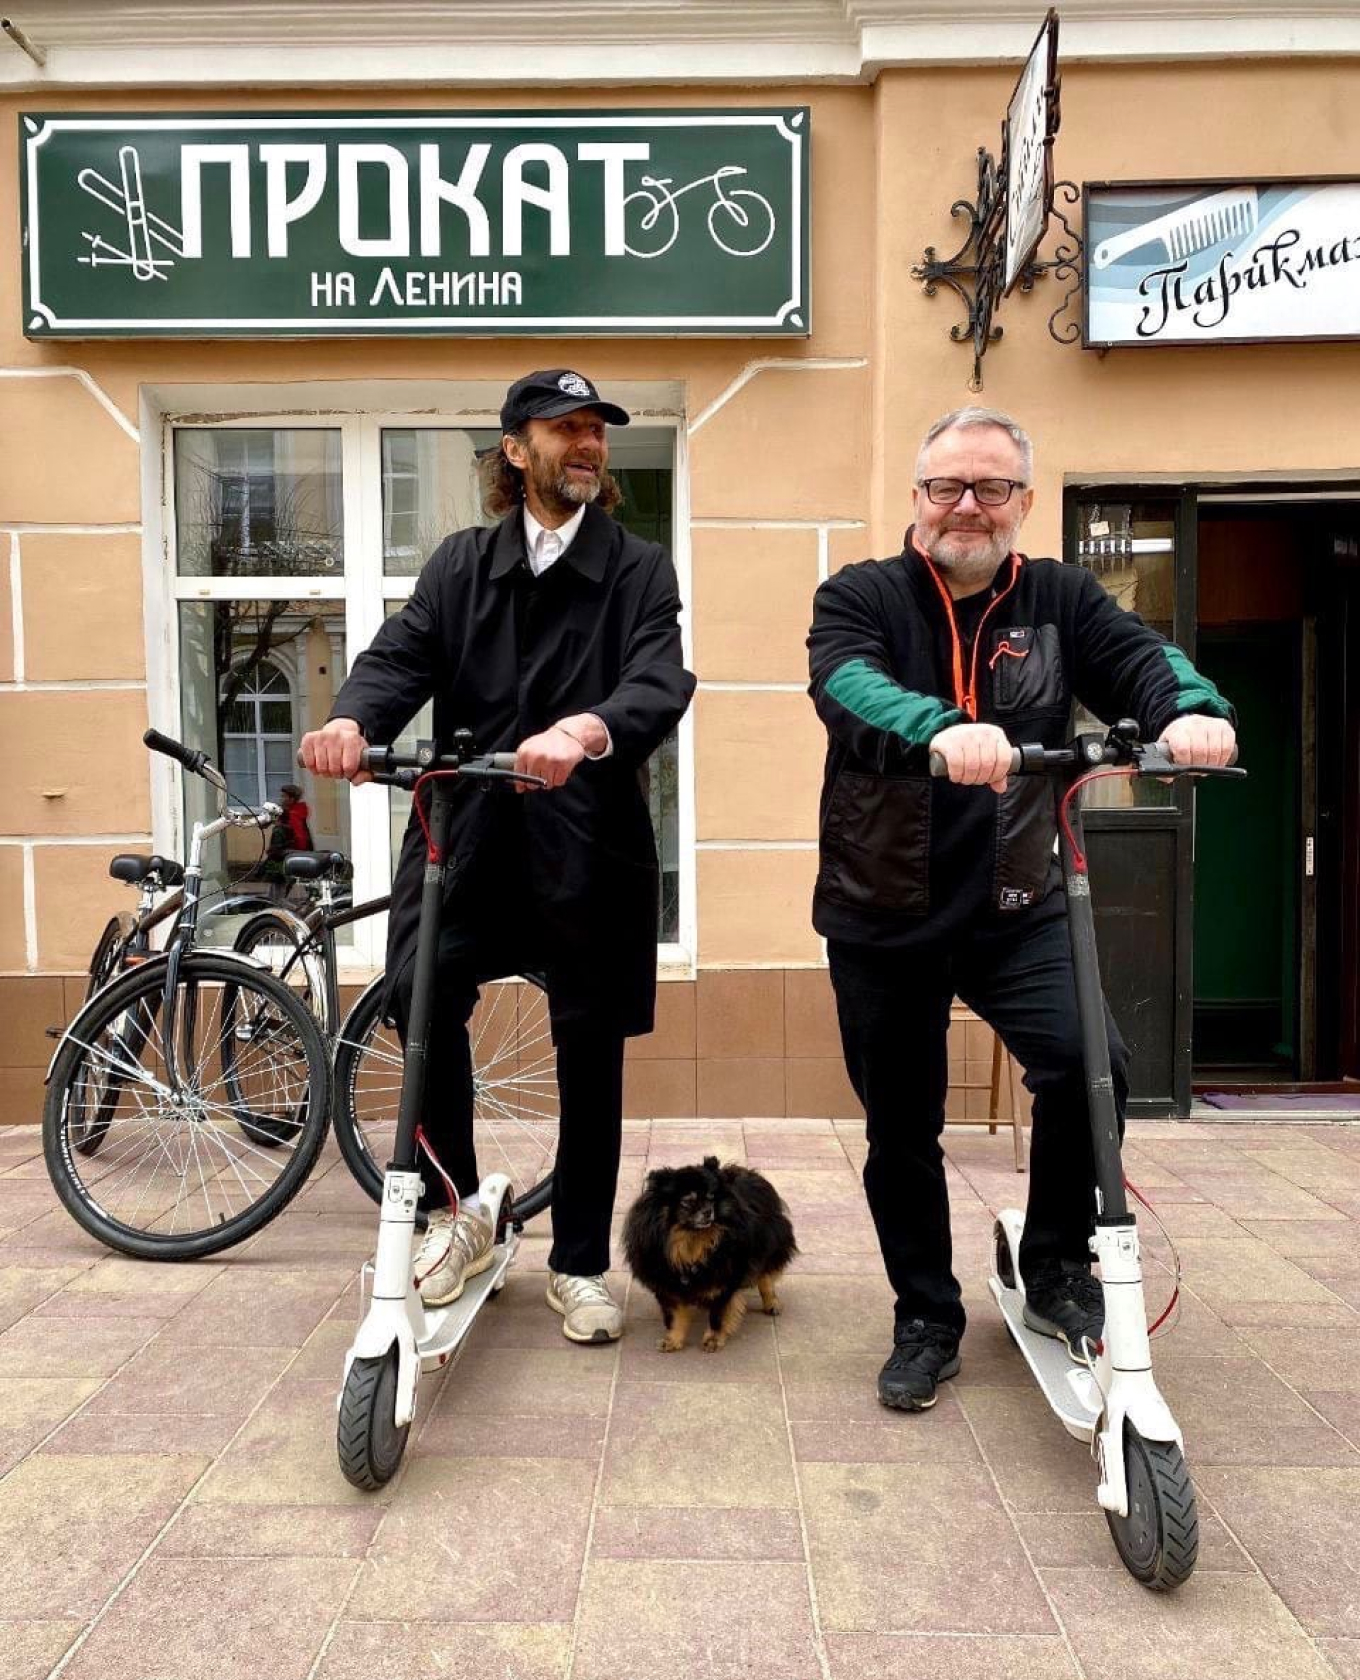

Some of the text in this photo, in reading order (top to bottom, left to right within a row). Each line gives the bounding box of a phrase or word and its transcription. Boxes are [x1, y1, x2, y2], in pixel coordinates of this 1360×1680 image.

[180, 142, 650, 259] ПРОКАТ
[311, 267, 522, 307] НА ЛЕНИНА
